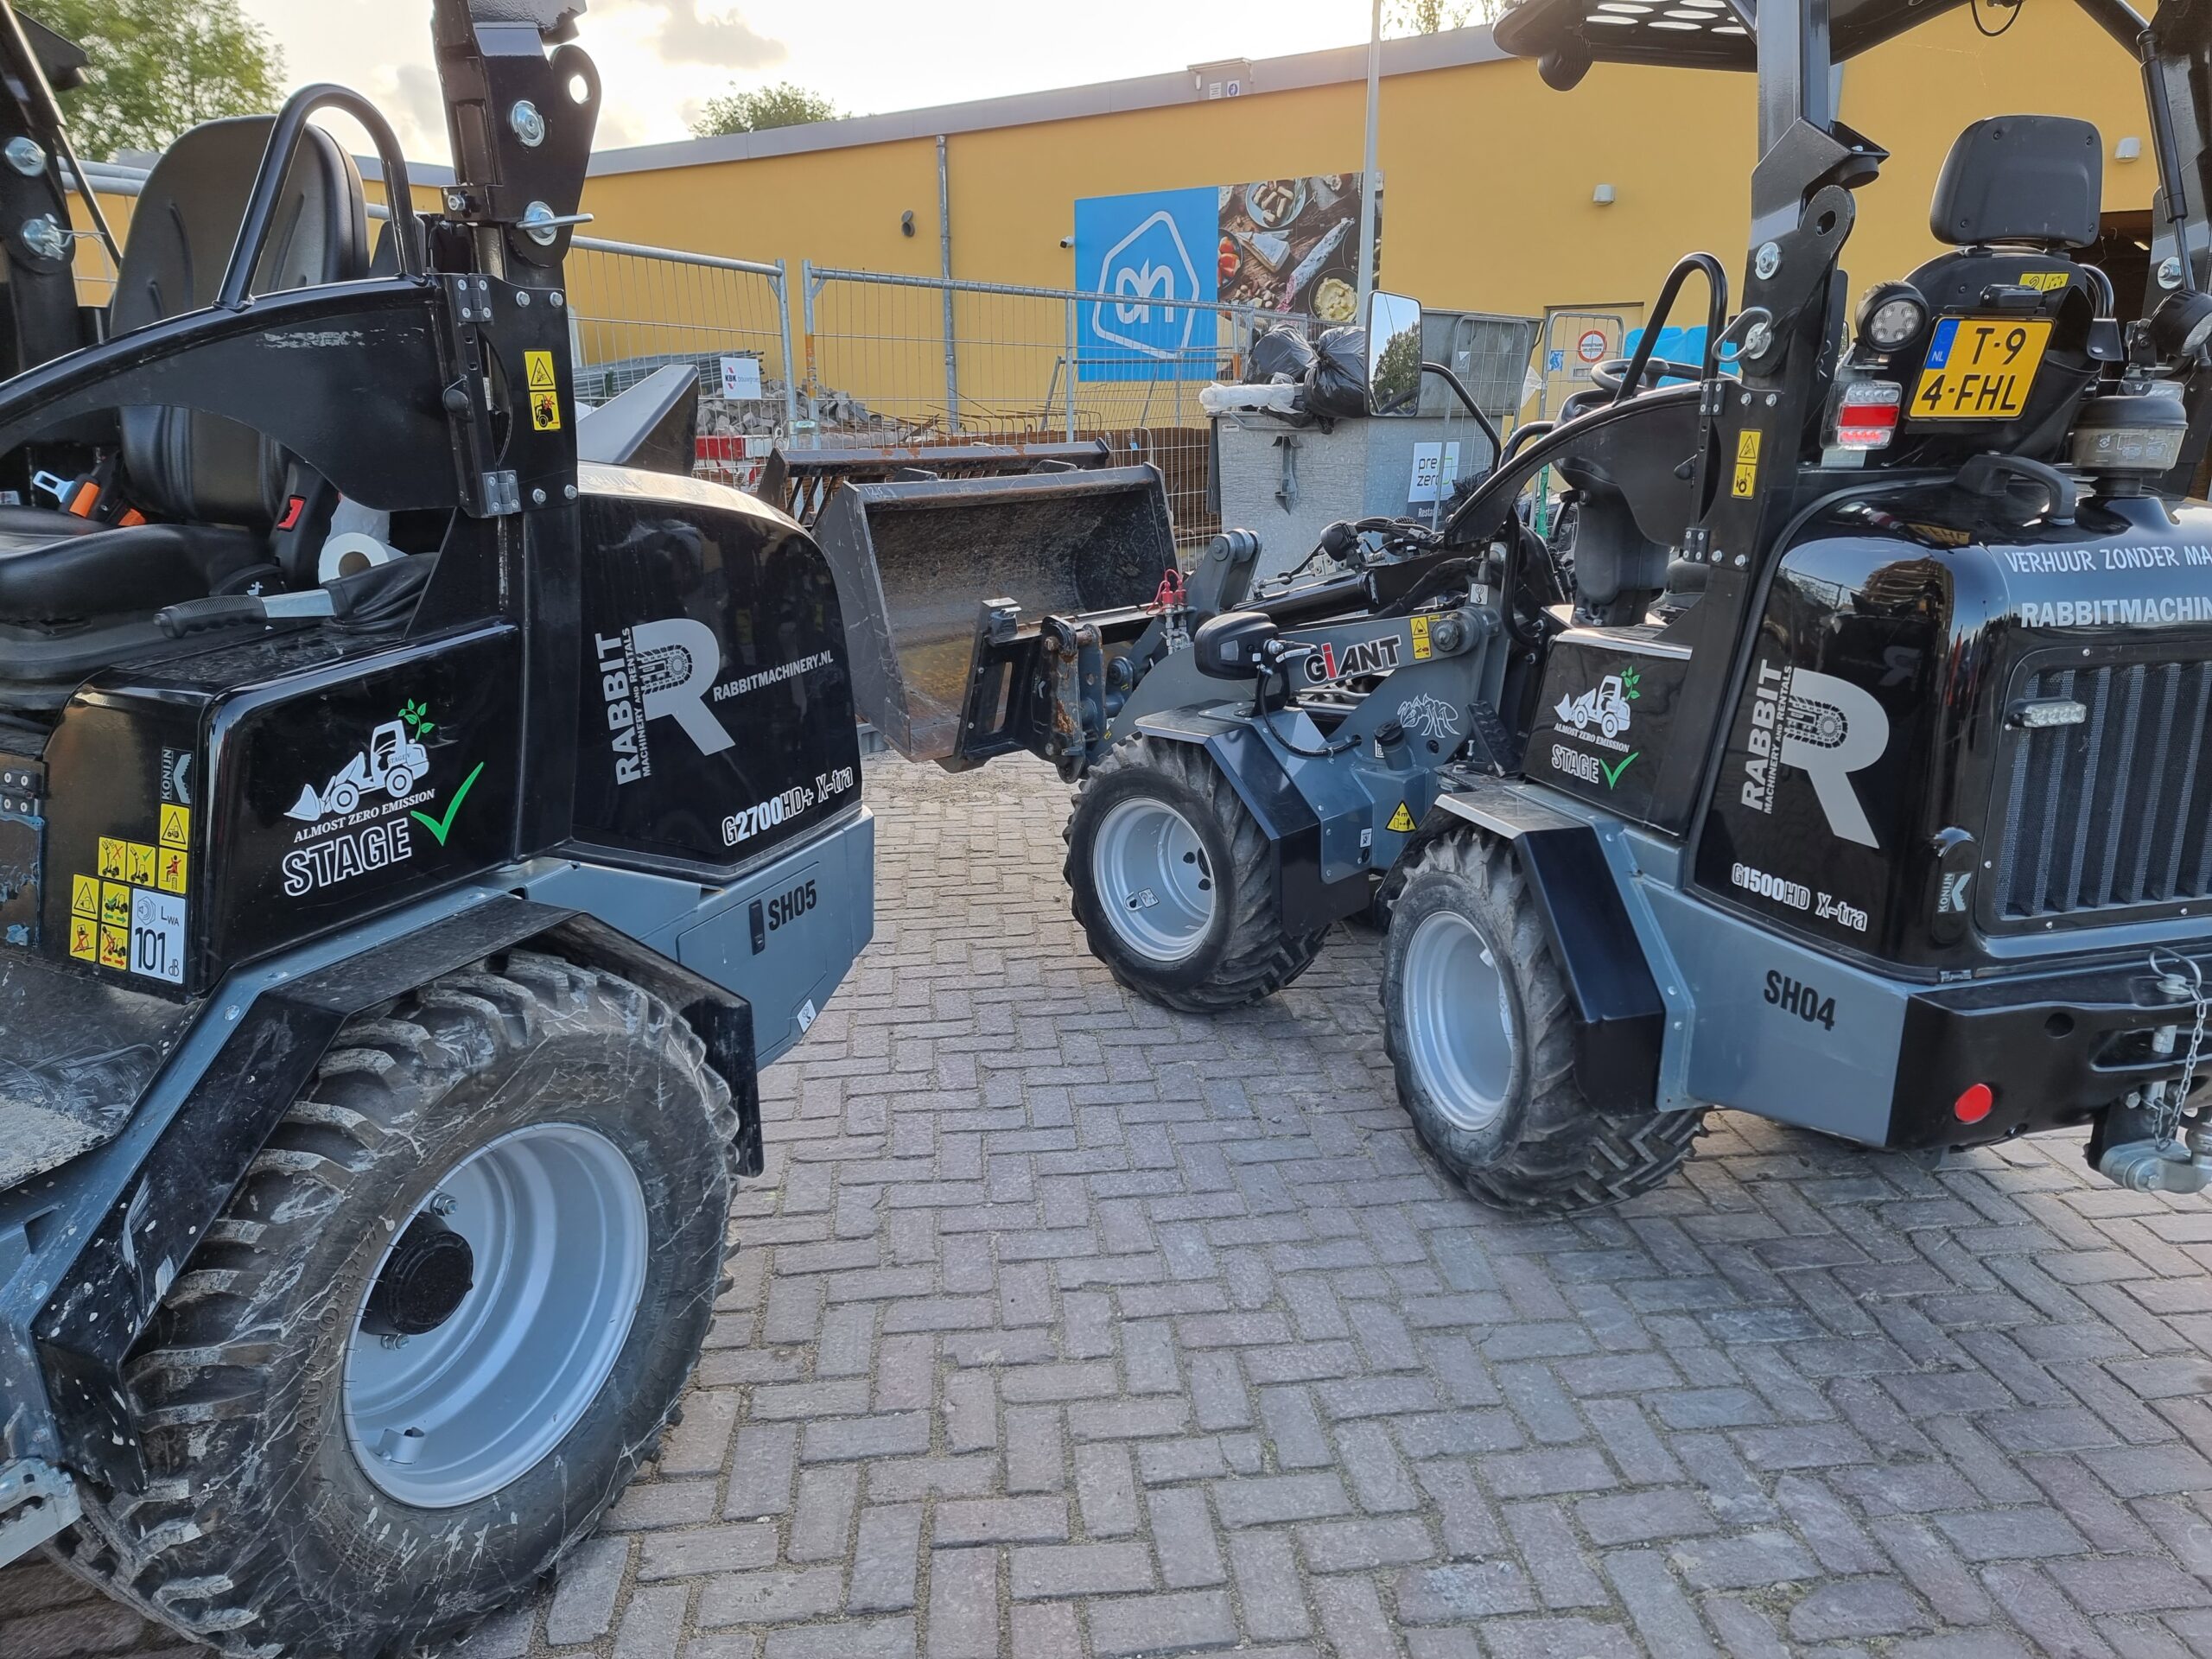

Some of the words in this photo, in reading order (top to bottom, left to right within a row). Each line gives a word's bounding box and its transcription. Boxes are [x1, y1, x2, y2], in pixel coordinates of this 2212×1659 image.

[1930, 350, 1944, 362] NL
[1972, 327, 2026, 365] T-9
[1920, 373, 2017, 411] 4-FHL
[1418, 457, 1438, 474] pre
[2004, 549, 2097, 573] VERHUUR
[2099, 545, 2181, 570] ZONDER
[621, 626, 639, 683] RENTALS
[712, 649, 835, 702] RABBITMACHINERY.NL
[594, 632, 642, 785] RABBIT
[632, 685, 643, 704] AND
[1776, 664, 1793, 721] RENTALS
[633, 708, 652, 778] MACHINERY
[1554, 722, 1580, 738] ALMOST
[1578, 730, 1596, 743] ZERO
[1594, 736, 1630, 753] EMISSION
[1740, 658, 1783, 810] RABBIT
[1775, 723, 1783, 742] AND
[161, 748, 174, 801] KONIJN
[1551, 743, 1599, 785] STAGE
[1763, 742, 1781, 815] MACHINERY
[293, 817, 346, 844] ALMOST
[347, 806, 380, 826] ZERO
[381, 787, 436, 816] EMISSION
[721, 786, 815, 847] G2700HD+
[815, 766, 854, 804] X-tra
[282, 817, 413, 897] STAGE
[1731, 861, 1811, 911] G1500HD
[1815, 891, 1869, 932] X-tra
[1937, 873, 1955, 913] KONIJN
[135, 926, 167, 975] 101
[168, 958, 181, 978] dB
